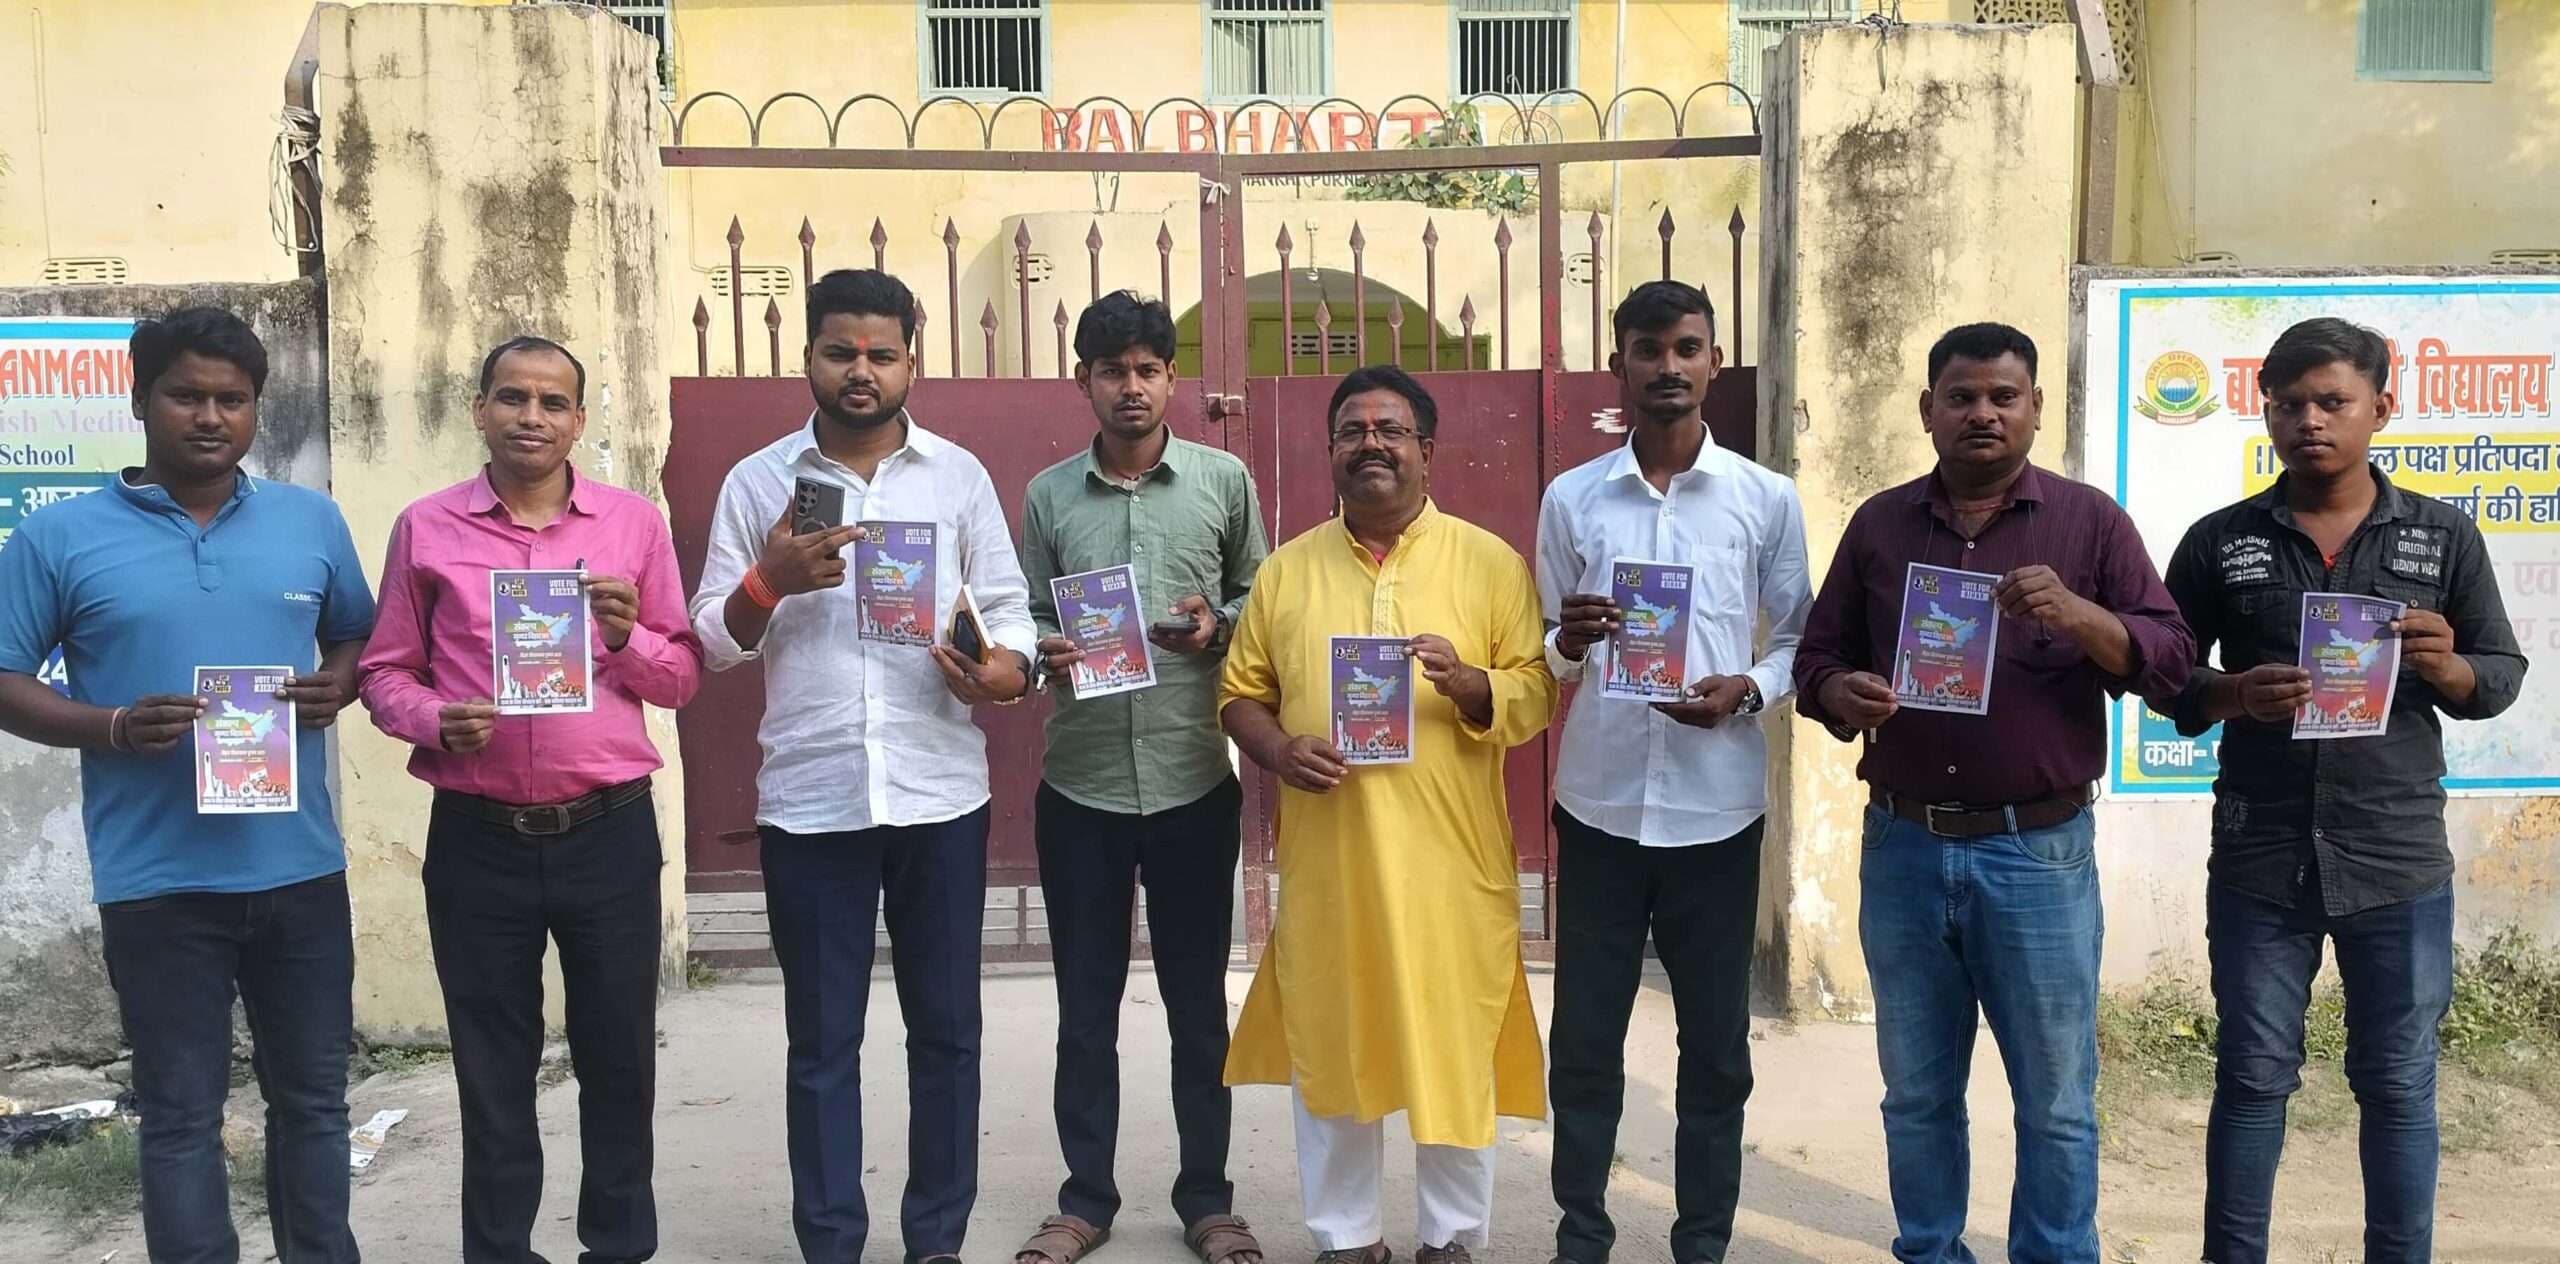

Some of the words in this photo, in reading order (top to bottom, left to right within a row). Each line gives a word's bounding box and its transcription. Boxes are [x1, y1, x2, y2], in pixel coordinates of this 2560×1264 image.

[1176, 110, 1472, 152] BHART
[52, 409, 145, 433] Mediu
[0, 443, 75, 466] School
[2405, 445, 2447, 473] पक्ष
[2453, 435, 2551, 476] प्रतिपदा
[2486, 486, 2524, 522] की
[2398, 540, 2441, 558] ORIGINAL
[2392, 558, 2419, 574] DENIM
